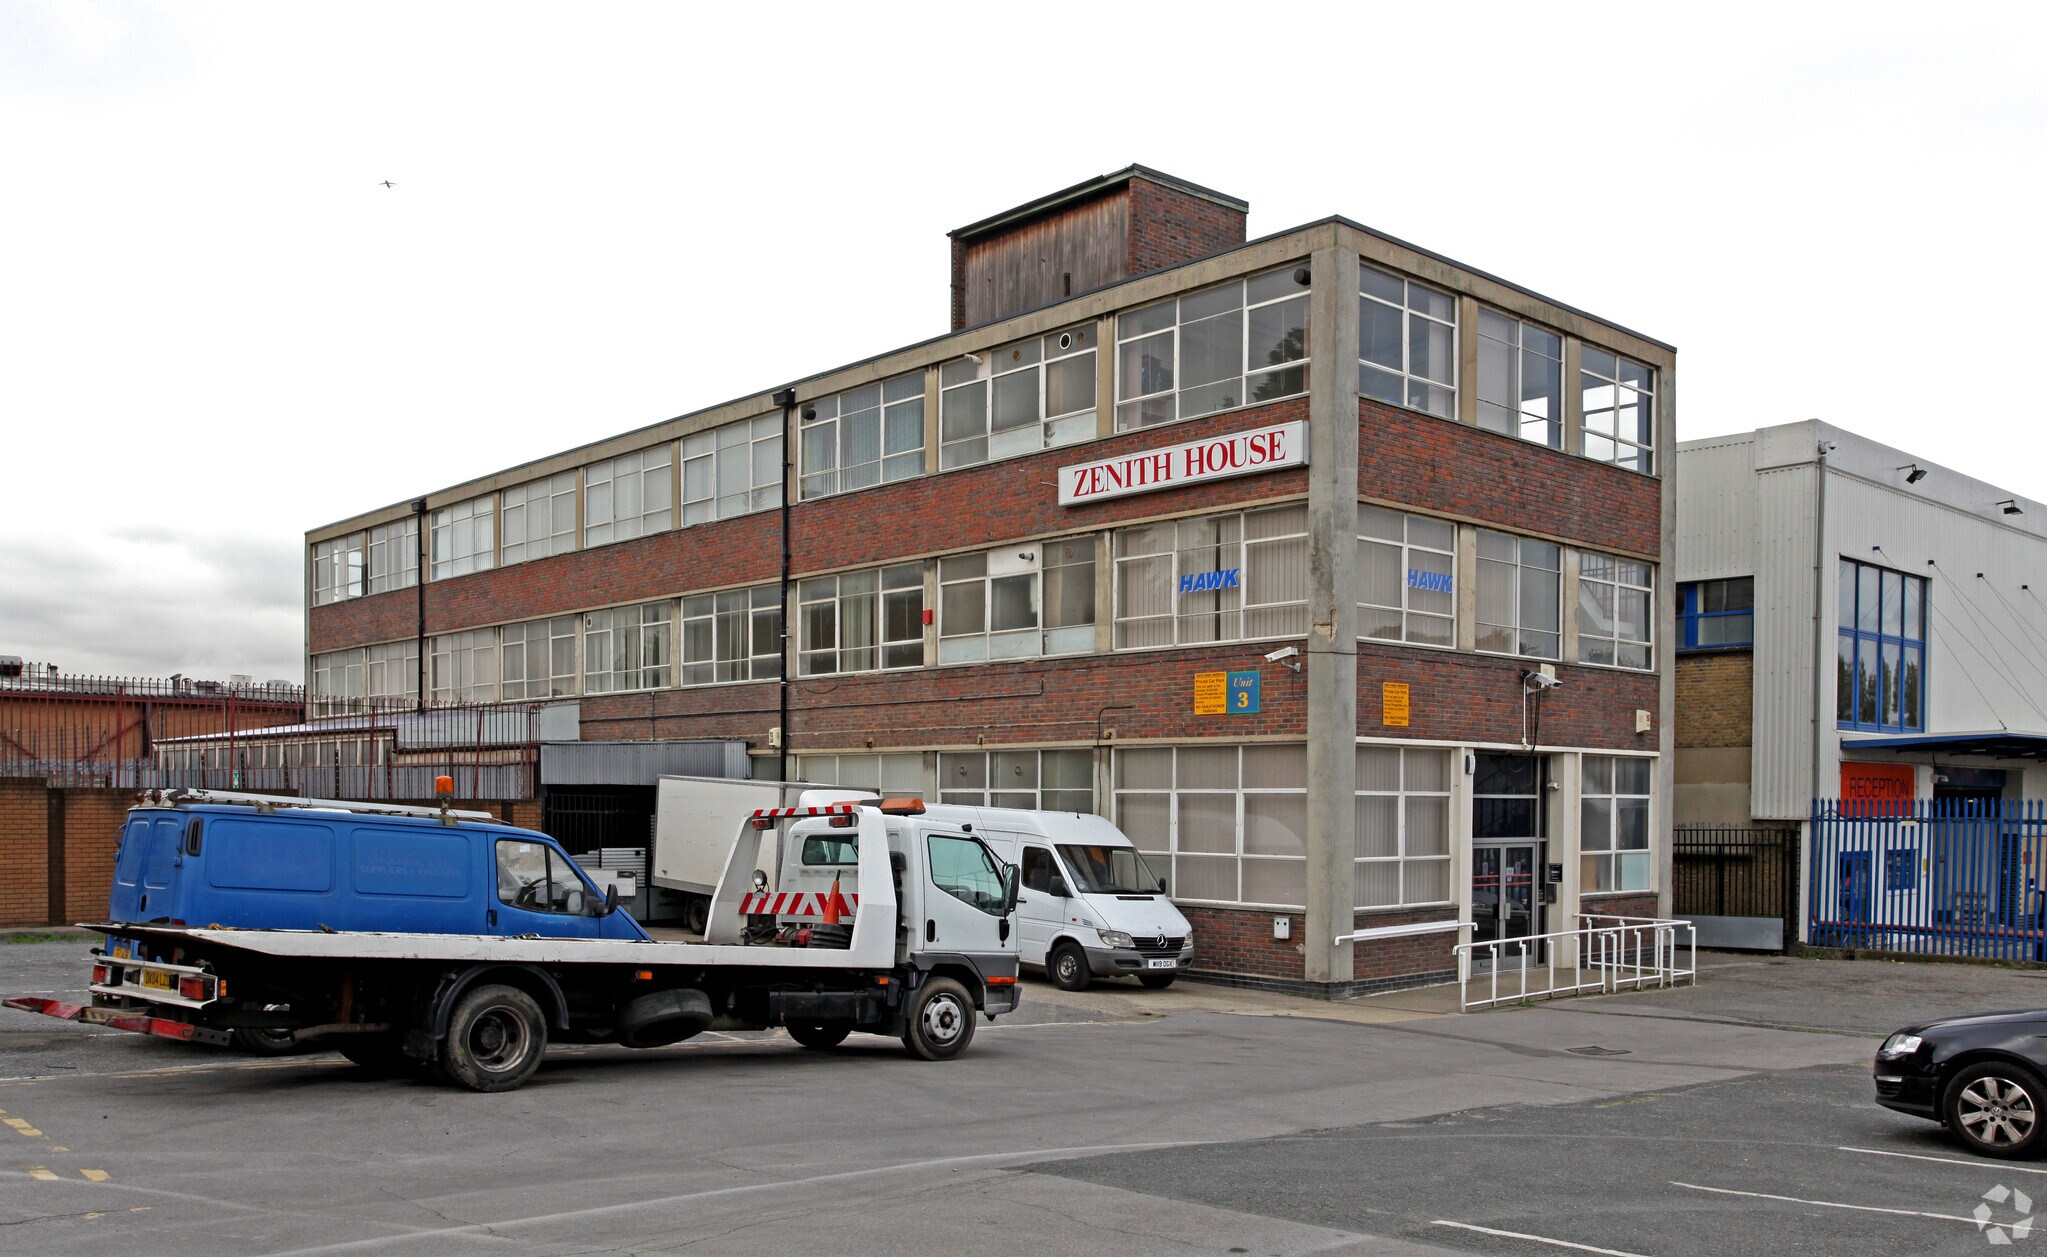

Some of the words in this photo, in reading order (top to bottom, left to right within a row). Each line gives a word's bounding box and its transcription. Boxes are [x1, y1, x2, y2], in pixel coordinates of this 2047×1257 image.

[1073, 451, 1173, 497] ZENITH
[1184, 430, 1287, 478] HOUSE
[1179, 568, 1240, 593] HAWK
[1408, 568, 1453, 593] HAWK
[1233, 677, 1253, 688] Unit
[1237, 692, 1249, 708] 3
[1849, 777, 1909, 798] RECEPTION
